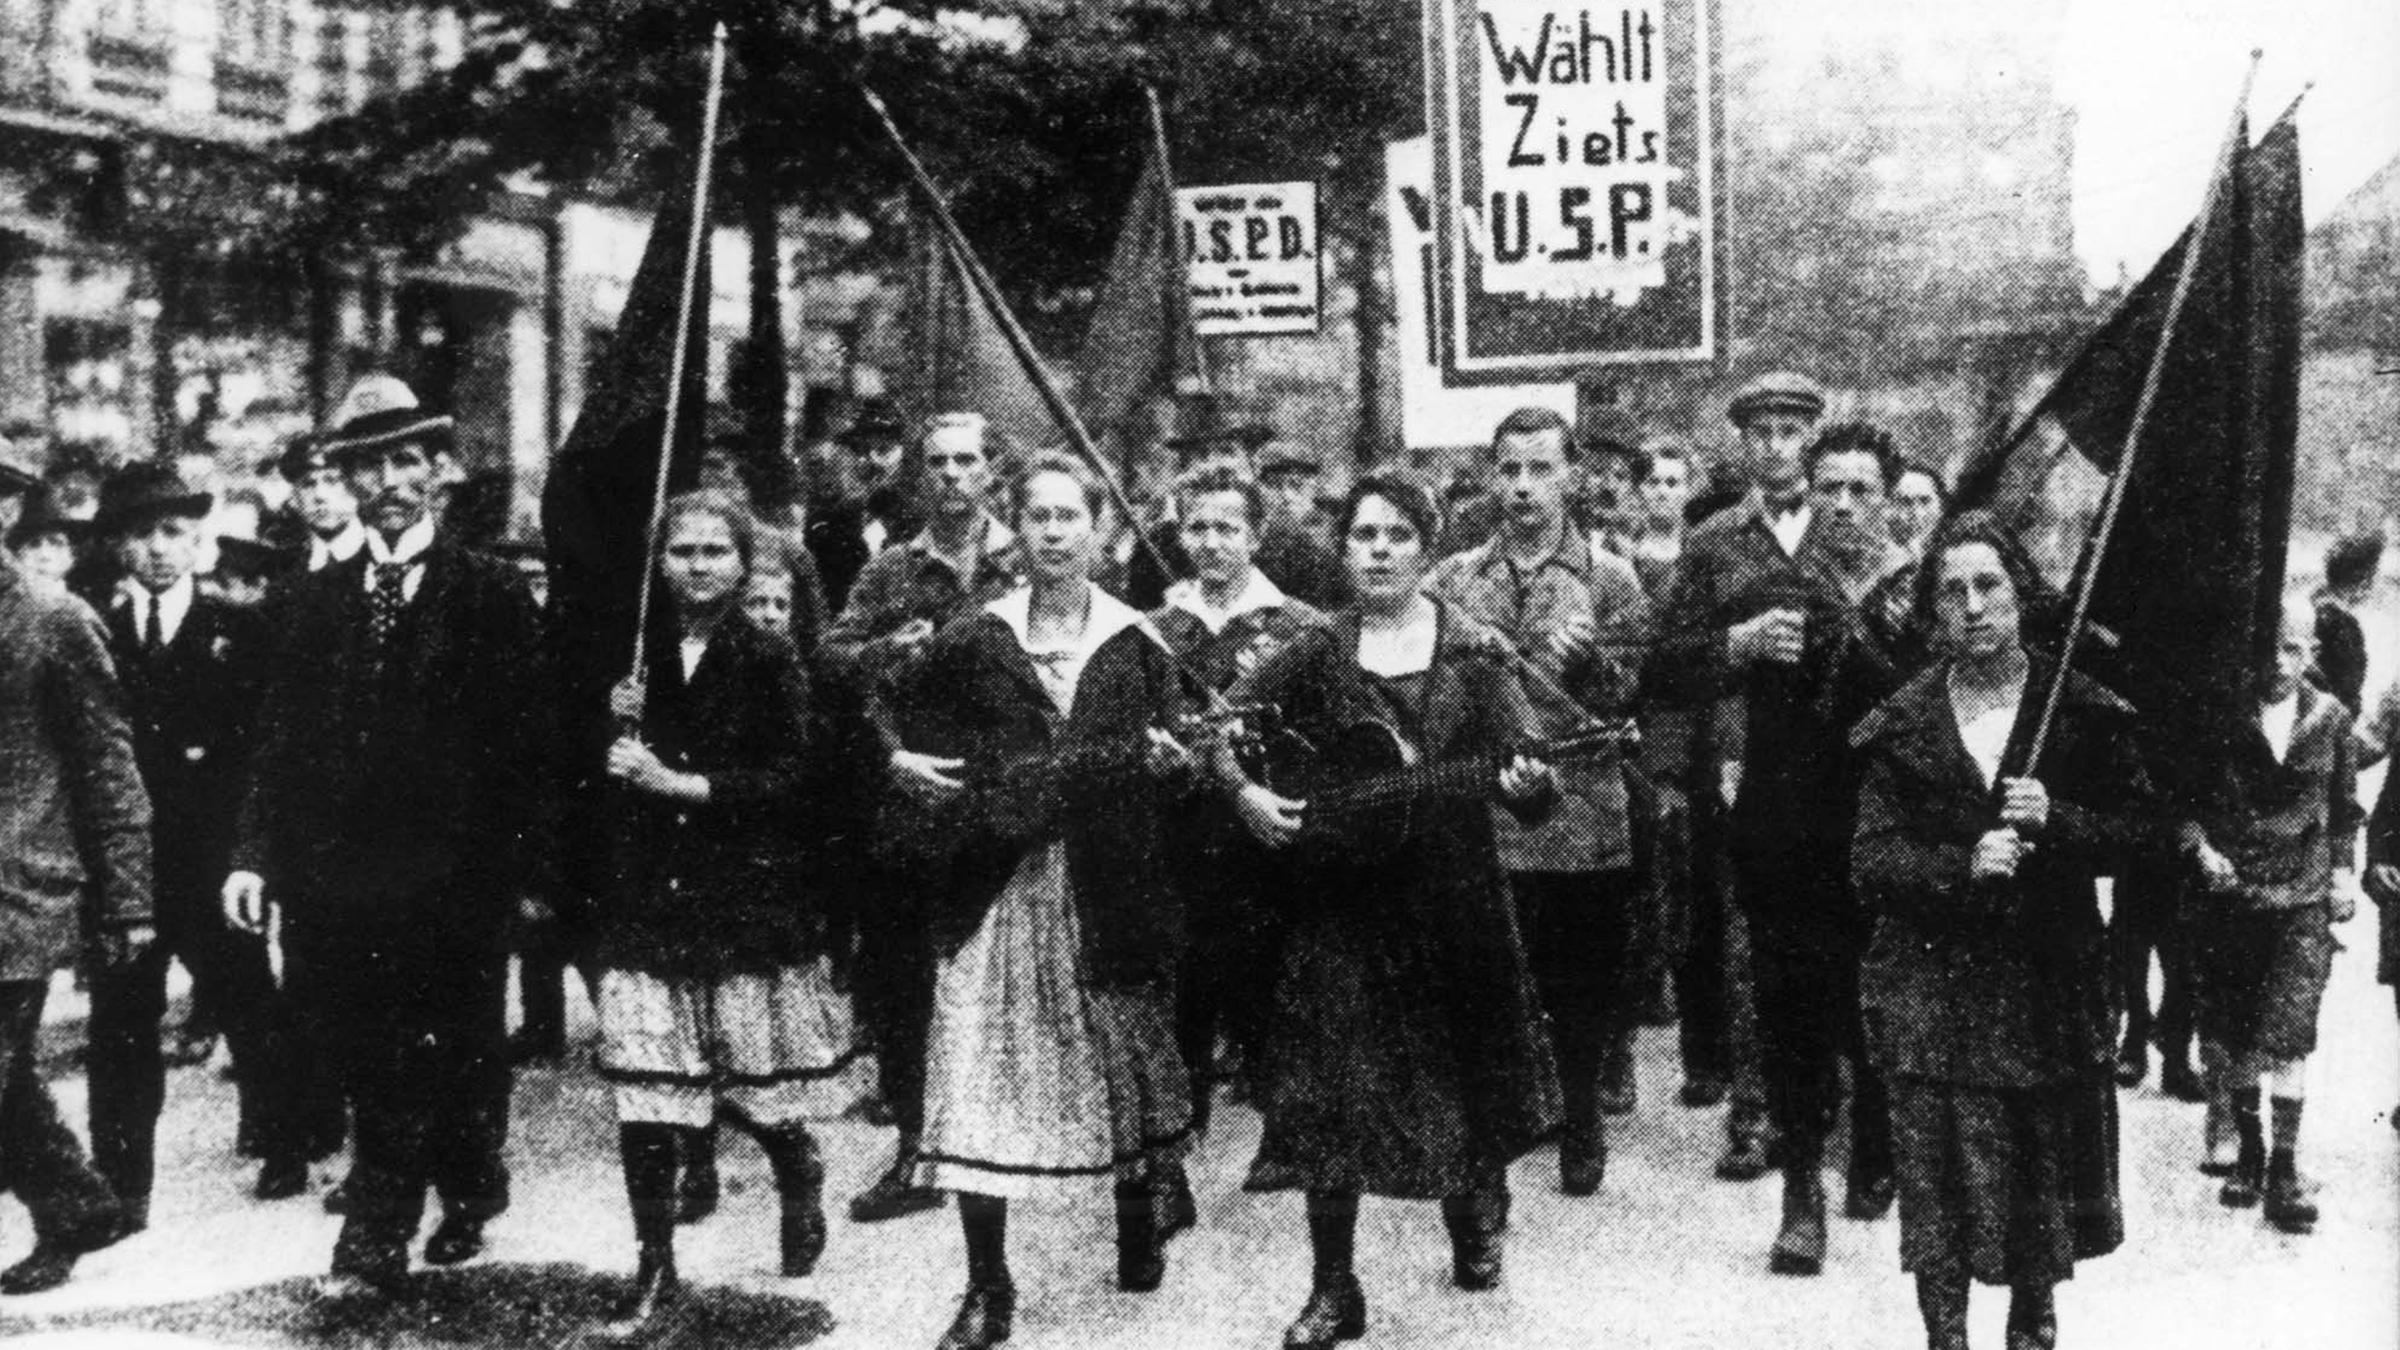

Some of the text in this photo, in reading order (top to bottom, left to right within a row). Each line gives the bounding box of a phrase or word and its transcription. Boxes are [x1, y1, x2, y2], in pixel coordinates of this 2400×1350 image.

[1482, 10, 1656, 84] Wählt
[1505, 93, 1659, 166] Ziets
[1491, 183, 1652, 263] U.S.P.
